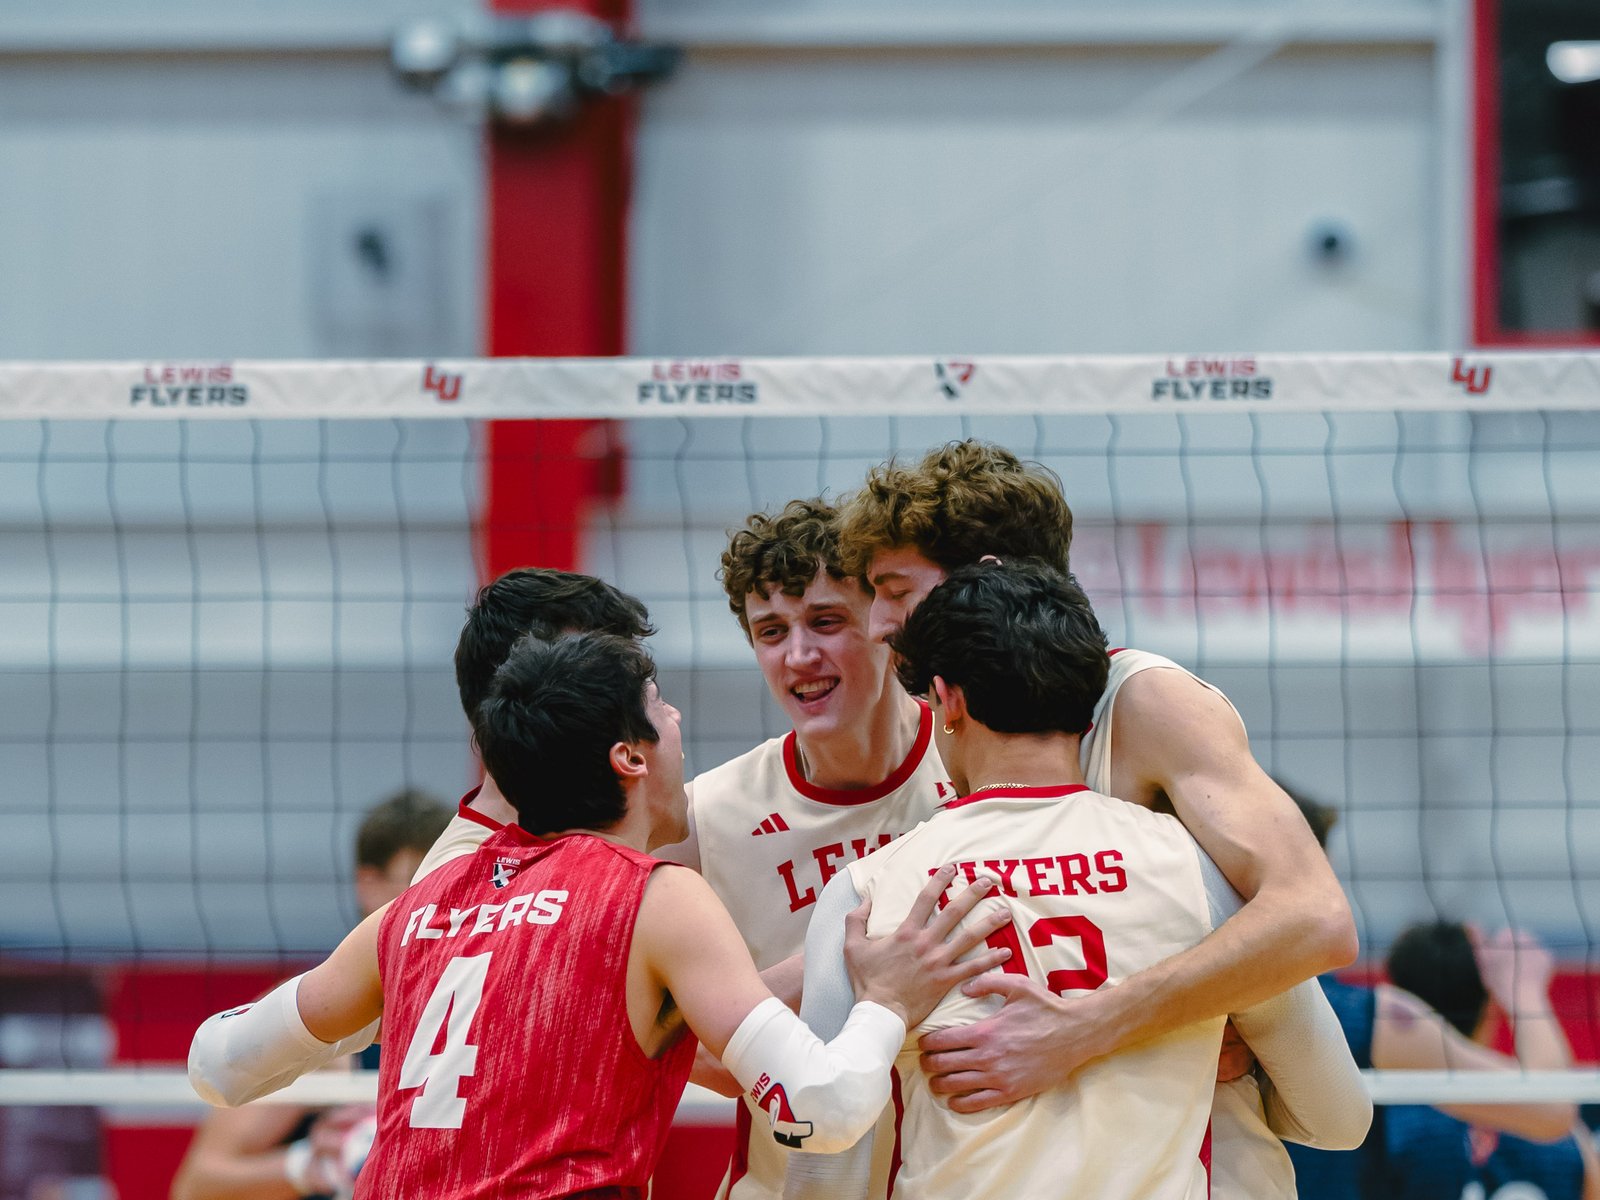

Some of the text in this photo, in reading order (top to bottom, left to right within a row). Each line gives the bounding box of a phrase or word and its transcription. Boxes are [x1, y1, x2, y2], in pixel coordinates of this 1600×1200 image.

[143, 366, 234, 384] LEWIS
[651, 363, 742, 381] LEWIS
[1165, 359, 1257, 377] LEWIS
[130, 385, 249, 407] FLYERS
[638, 383, 758, 404] FLYERS
[1151, 379, 1272, 401] FLYERS
[496, 856, 521, 866] LEWIS
[400, 889, 569, 947] FLYERS
[397, 951, 493, 1129] 4
